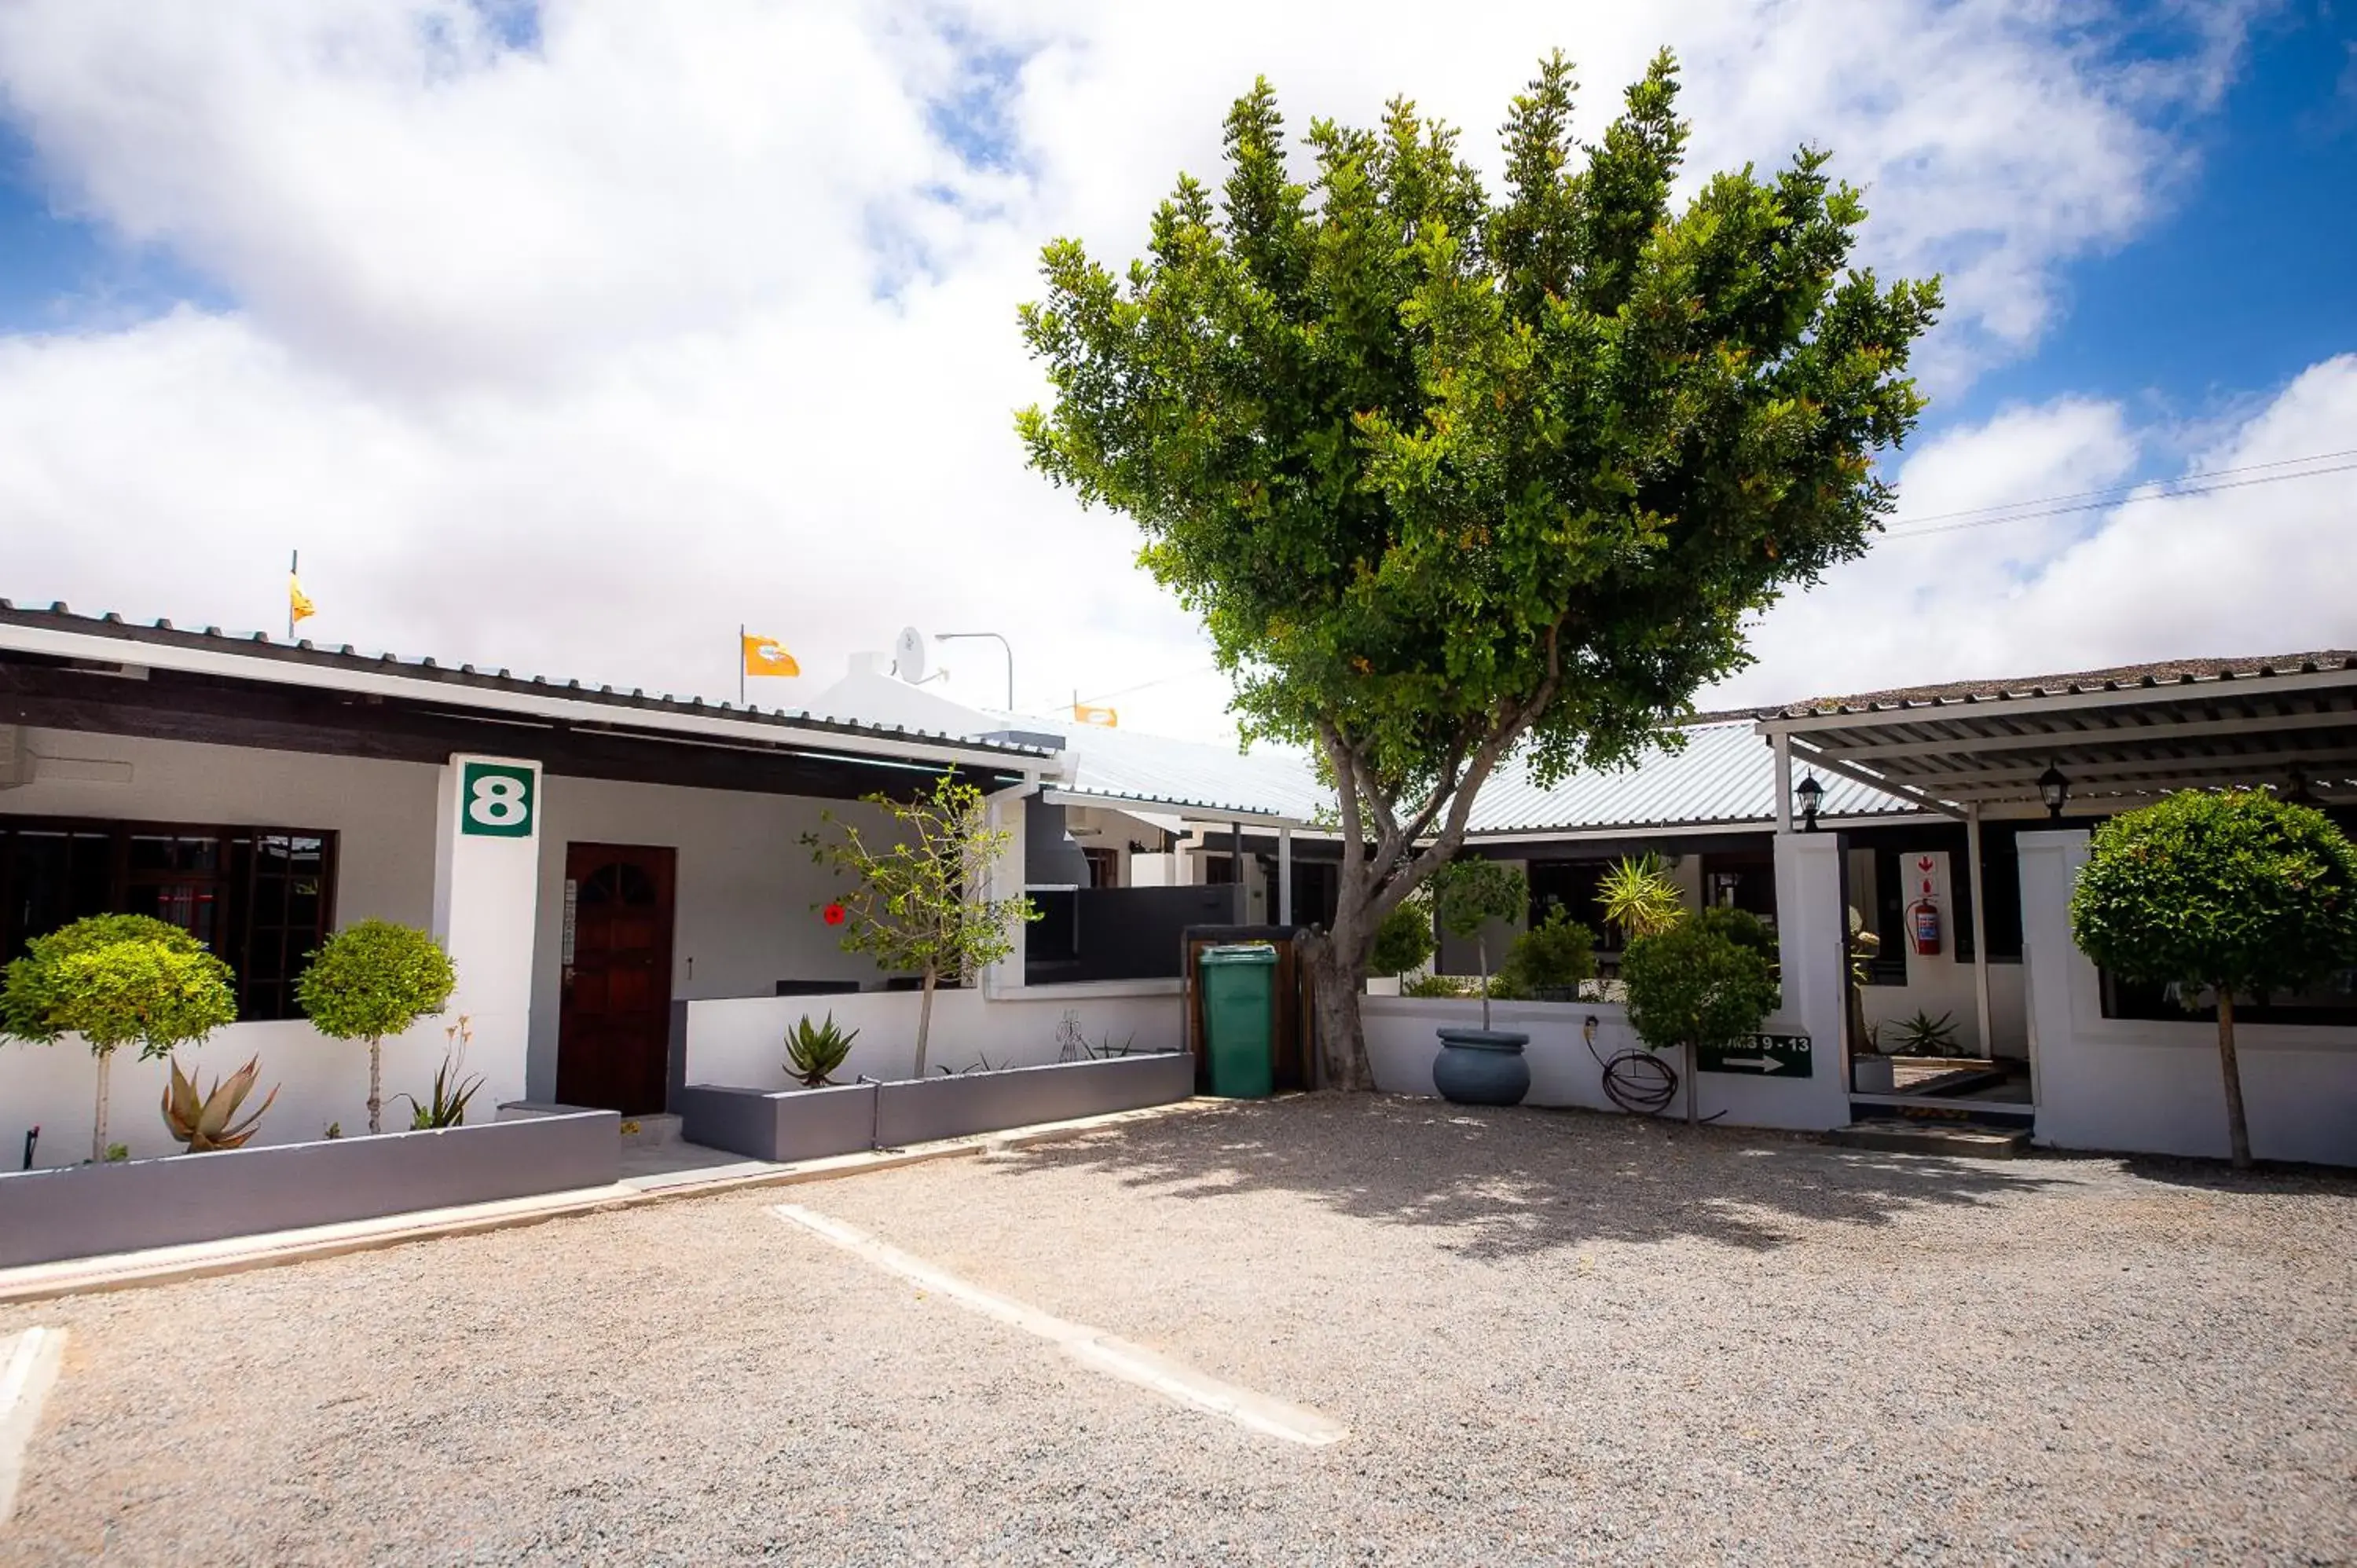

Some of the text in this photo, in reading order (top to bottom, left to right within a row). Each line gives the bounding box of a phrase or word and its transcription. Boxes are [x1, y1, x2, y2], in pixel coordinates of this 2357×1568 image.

[470, 775, 527, 826] 8
[1762, 1036, 1772, 1050] 9
[1787, 1038, 1809, 1052] 13
